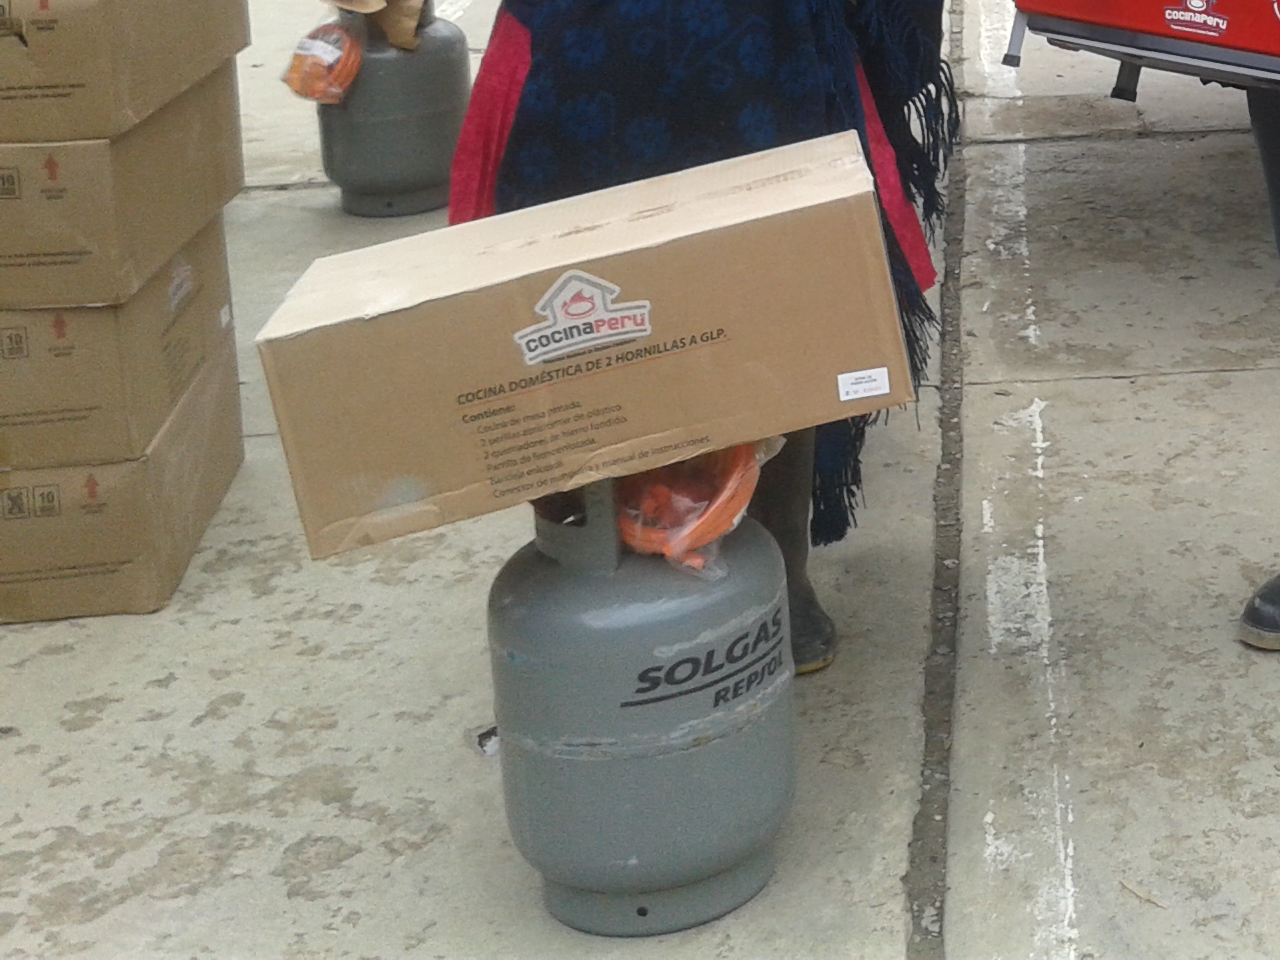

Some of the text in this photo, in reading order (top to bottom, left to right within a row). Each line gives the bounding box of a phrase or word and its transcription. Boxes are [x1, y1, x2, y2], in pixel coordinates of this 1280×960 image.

[457, 383, 506, 406] COCINA
[508, 364, 583, 393] DOMÉSTICA
[586, 357, 602, 373] DE
[605, 355, 613, 367] 2
[615, 336, 687, 365] HORNILLAS
[688, 337, 698, 346] A
[635, 607, 782, 693] SOLGAS
[713, 650, 783, 708] REPSOL
